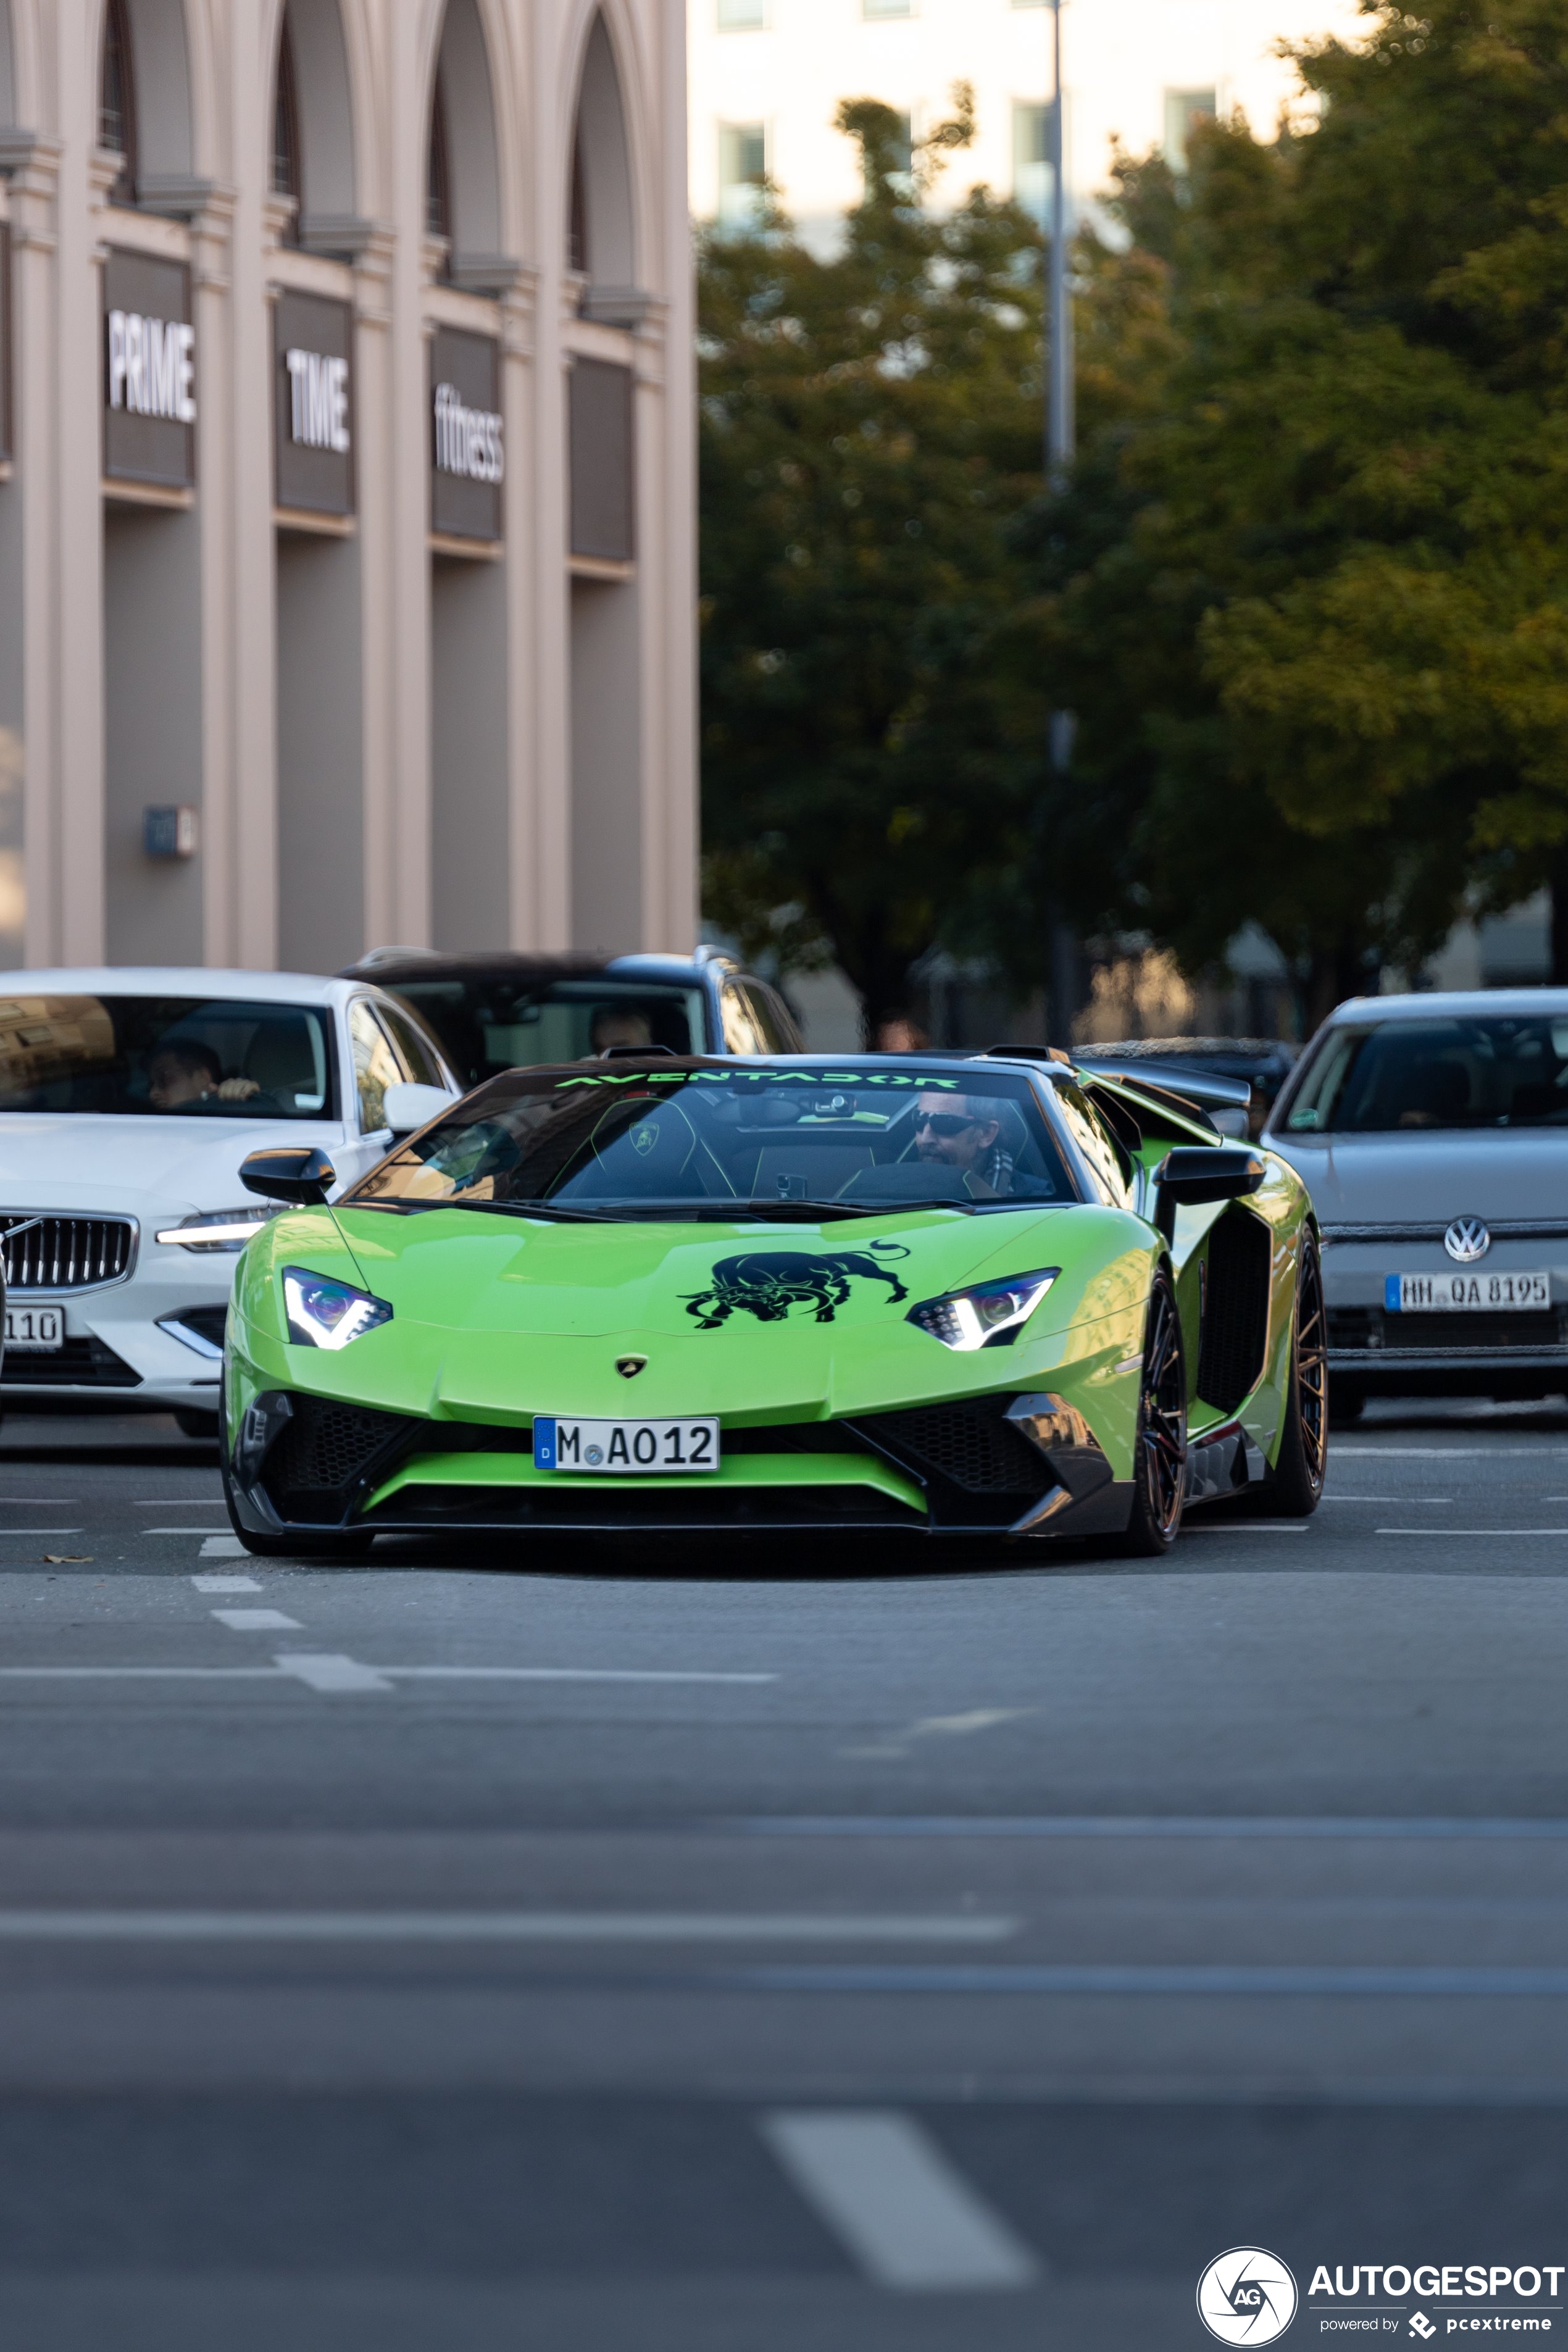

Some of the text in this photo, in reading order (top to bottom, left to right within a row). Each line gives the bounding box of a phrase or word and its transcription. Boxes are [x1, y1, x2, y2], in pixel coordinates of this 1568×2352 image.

[109, 309, 196, 422] PRIME
[286, 348, 351, 454] TIME
[435, 382, 504, 483] fitness
[555, 1072, 960, 1088] AVENTADOR
[1403, 1277, 1433, 1304] HH
[1488, 1275, 1547, 1301] 8195
[541, 1448, 550, 1459] D
[557, 1425, 580, 1463] M
